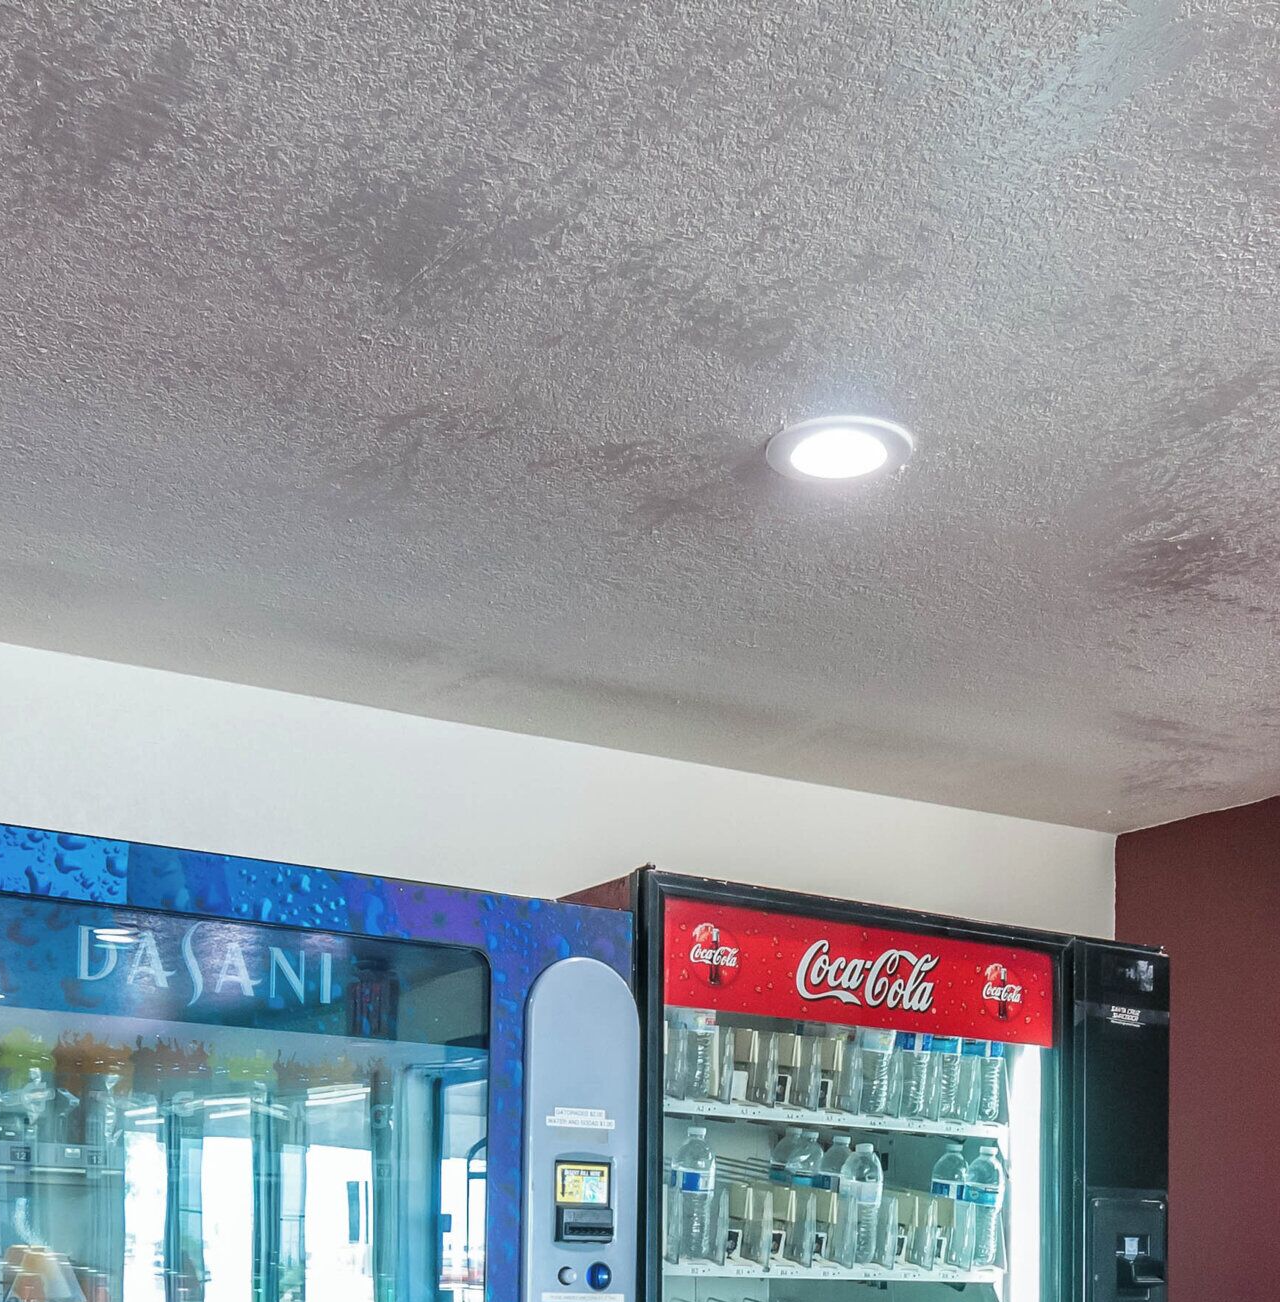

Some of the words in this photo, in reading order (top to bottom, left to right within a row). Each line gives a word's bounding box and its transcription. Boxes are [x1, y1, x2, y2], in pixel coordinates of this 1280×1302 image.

[76, 921, 332, 1007] DASANI
[689, 944, 739, 968] Coca-Cola
[797, 939, 940, 1012] Coca-Cola
[982, 983, 1022, 1003] Coca-Cola
